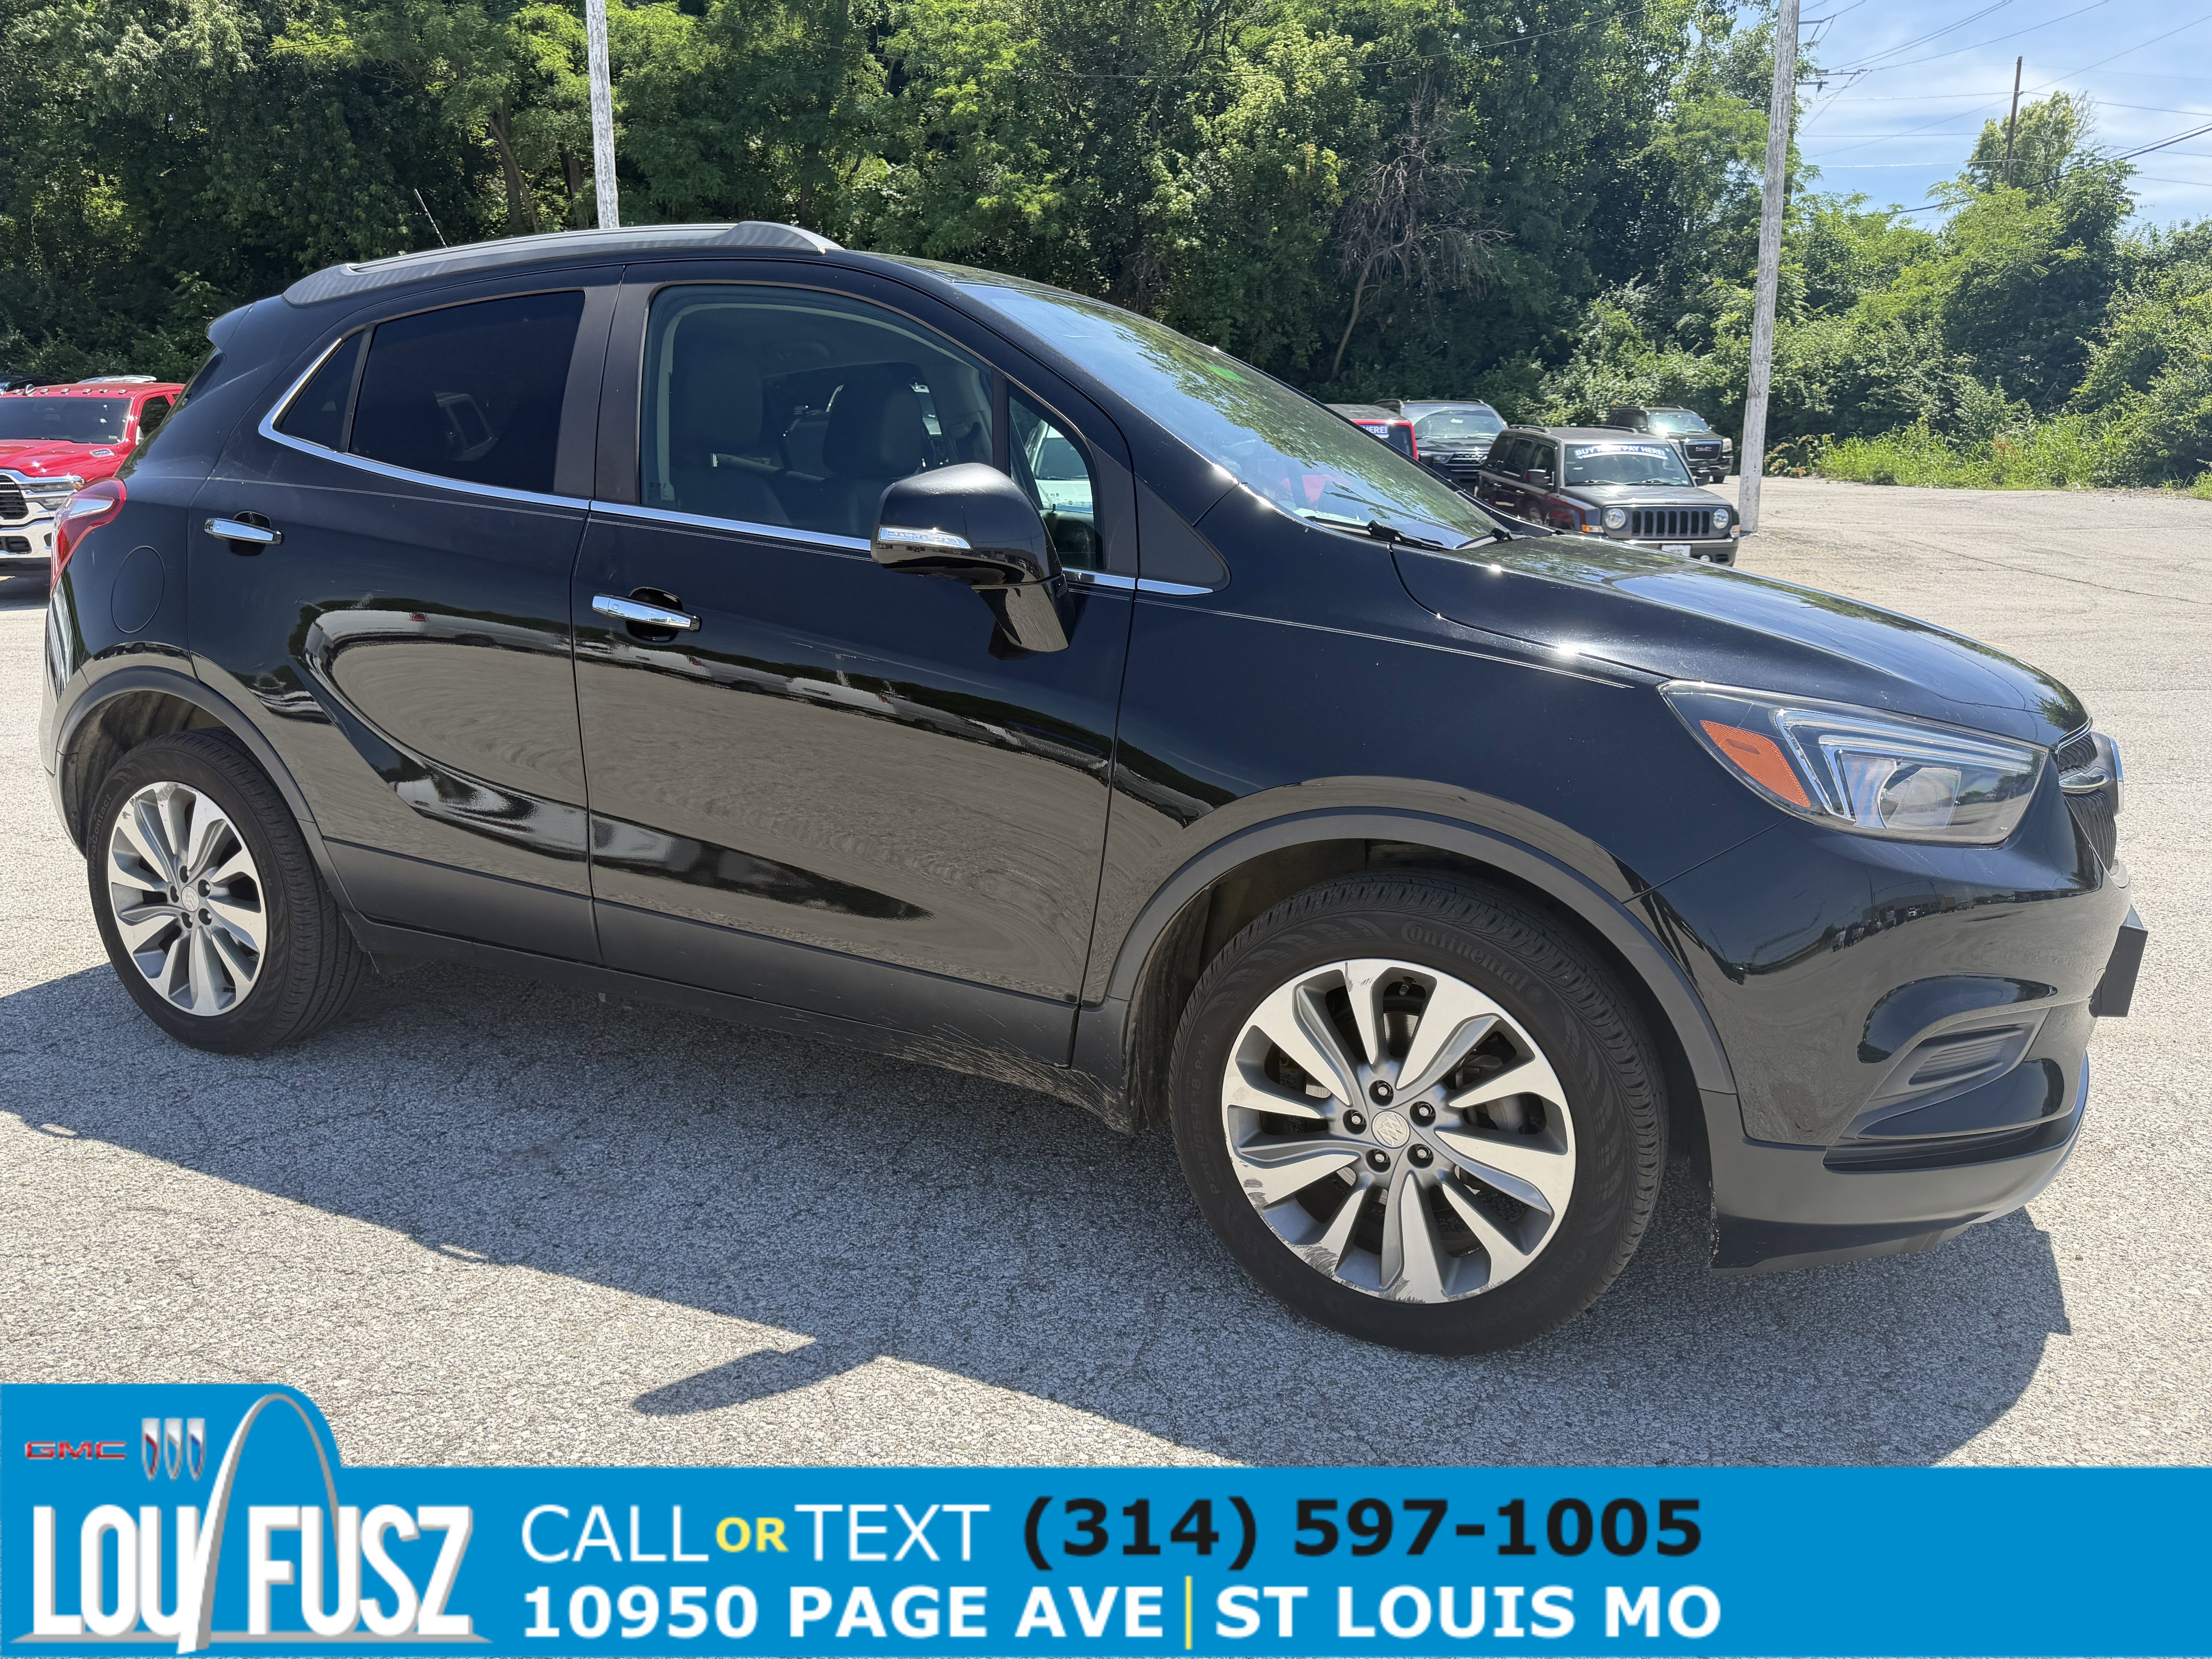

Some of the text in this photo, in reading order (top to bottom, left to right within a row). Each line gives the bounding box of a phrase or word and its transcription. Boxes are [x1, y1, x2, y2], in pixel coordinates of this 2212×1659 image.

[1575, 446, 1595, 456] BUY
[1640, 447, 1665, 456] HERE!
[1401, 920, 1532, 992] Continental
[1191, 1034, 1221, 1195] P215/55 R 18 94 H
